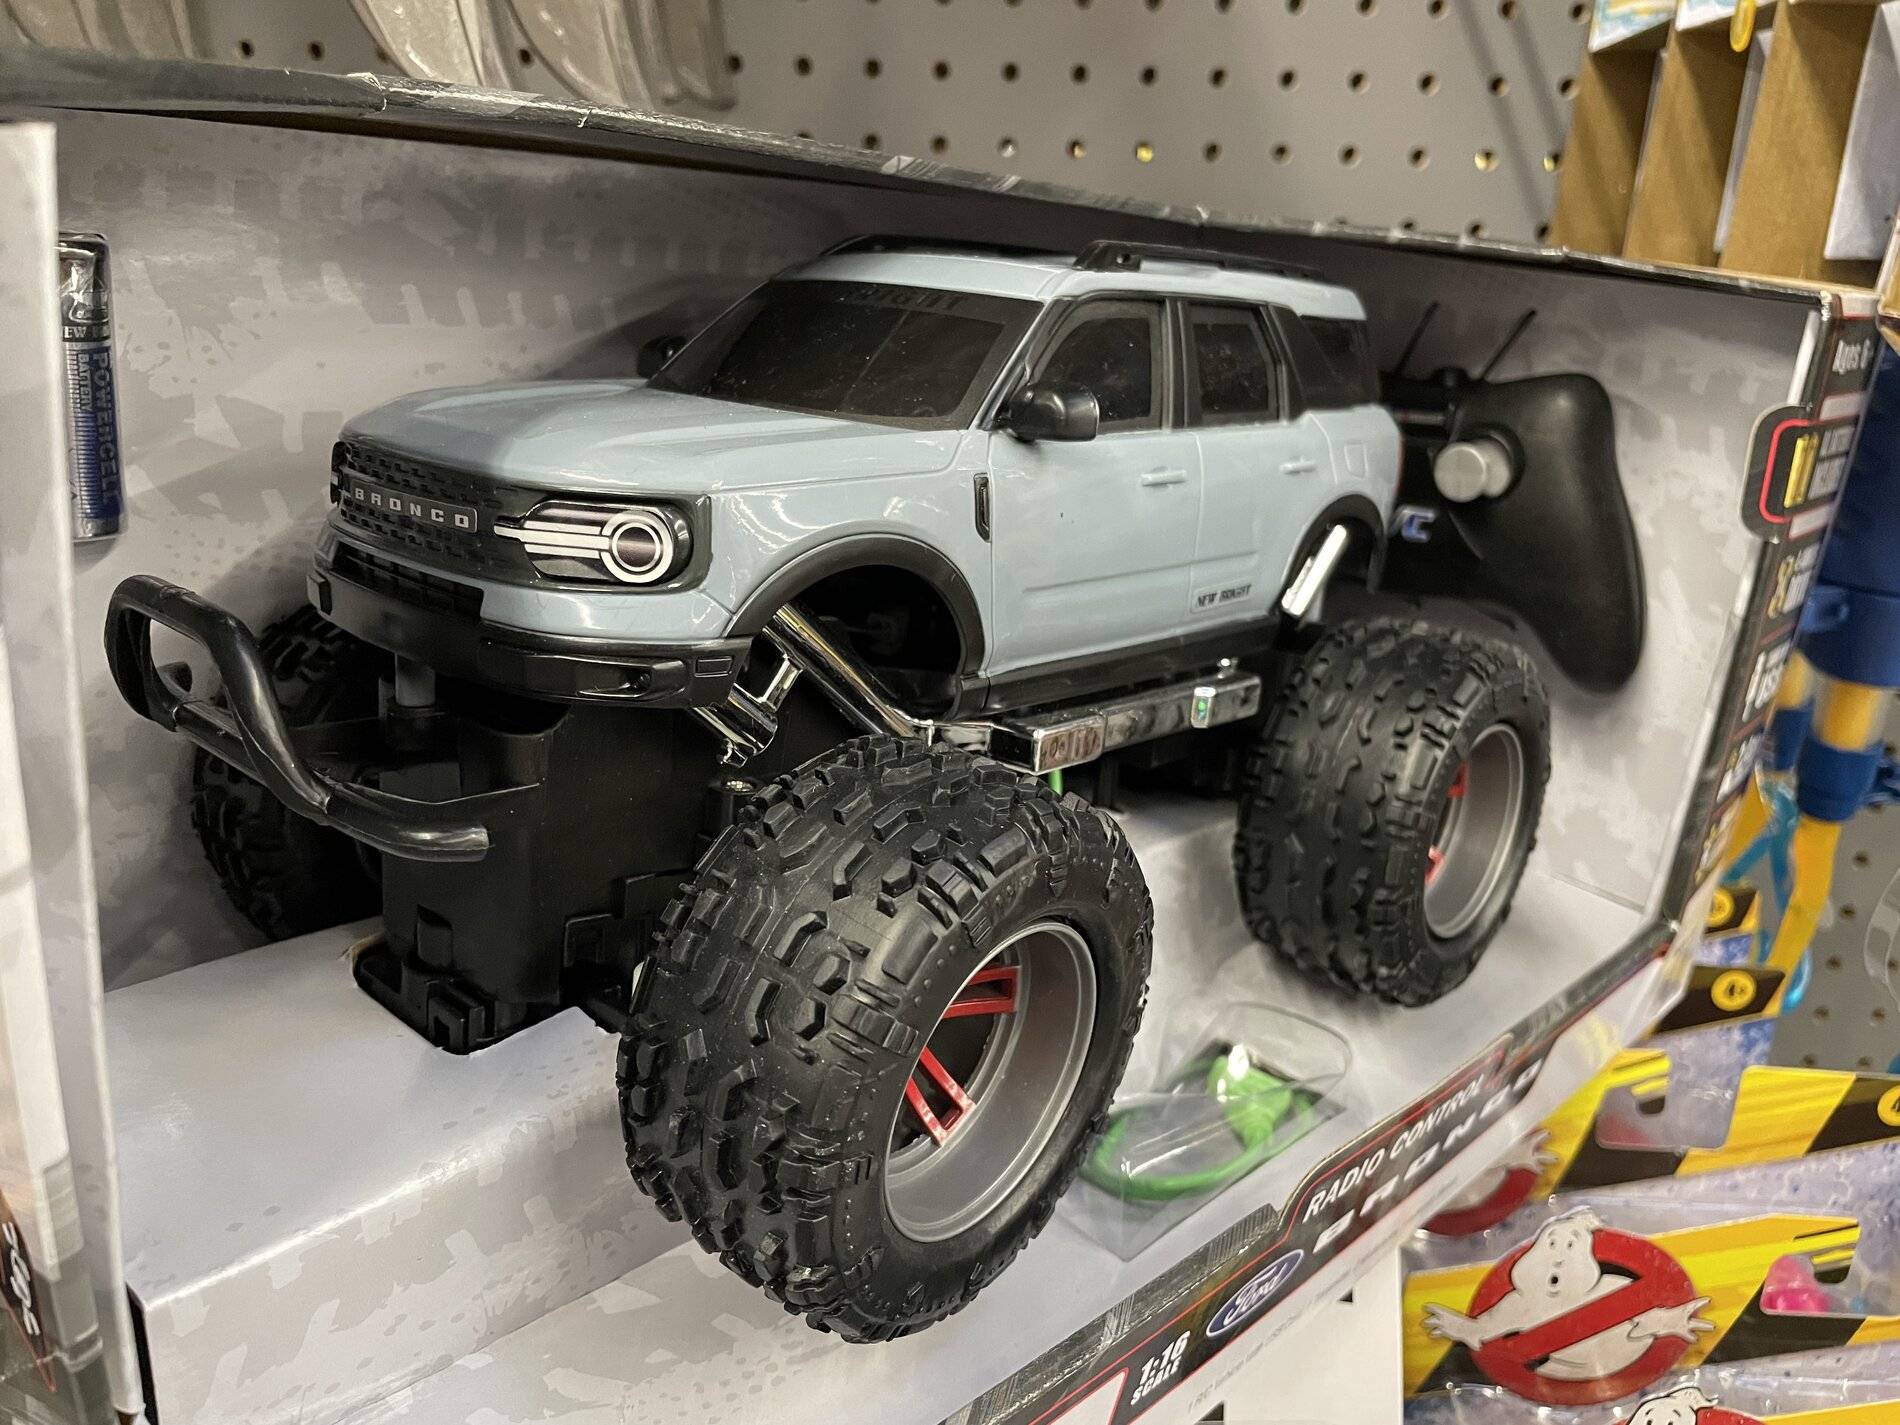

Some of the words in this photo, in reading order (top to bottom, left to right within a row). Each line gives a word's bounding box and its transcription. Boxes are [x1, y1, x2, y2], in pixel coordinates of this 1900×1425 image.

[63, 325, 87, 338] EW
[78, 352, 94, 412] BATTERY
[355, 487, 469, 529] BRONCO
[1302, 1147, 1386, 1225] RADIO
[1389, 1074, 1484, 1160] CONTROL
[1312, 1058, 1543, 1254] BRONCO
[1221, 1259, 1290, 1327] Ford
[1130, 1356, 1182, 1406] SCALE
[1139, 1330, 1191, 1386] 1:16
